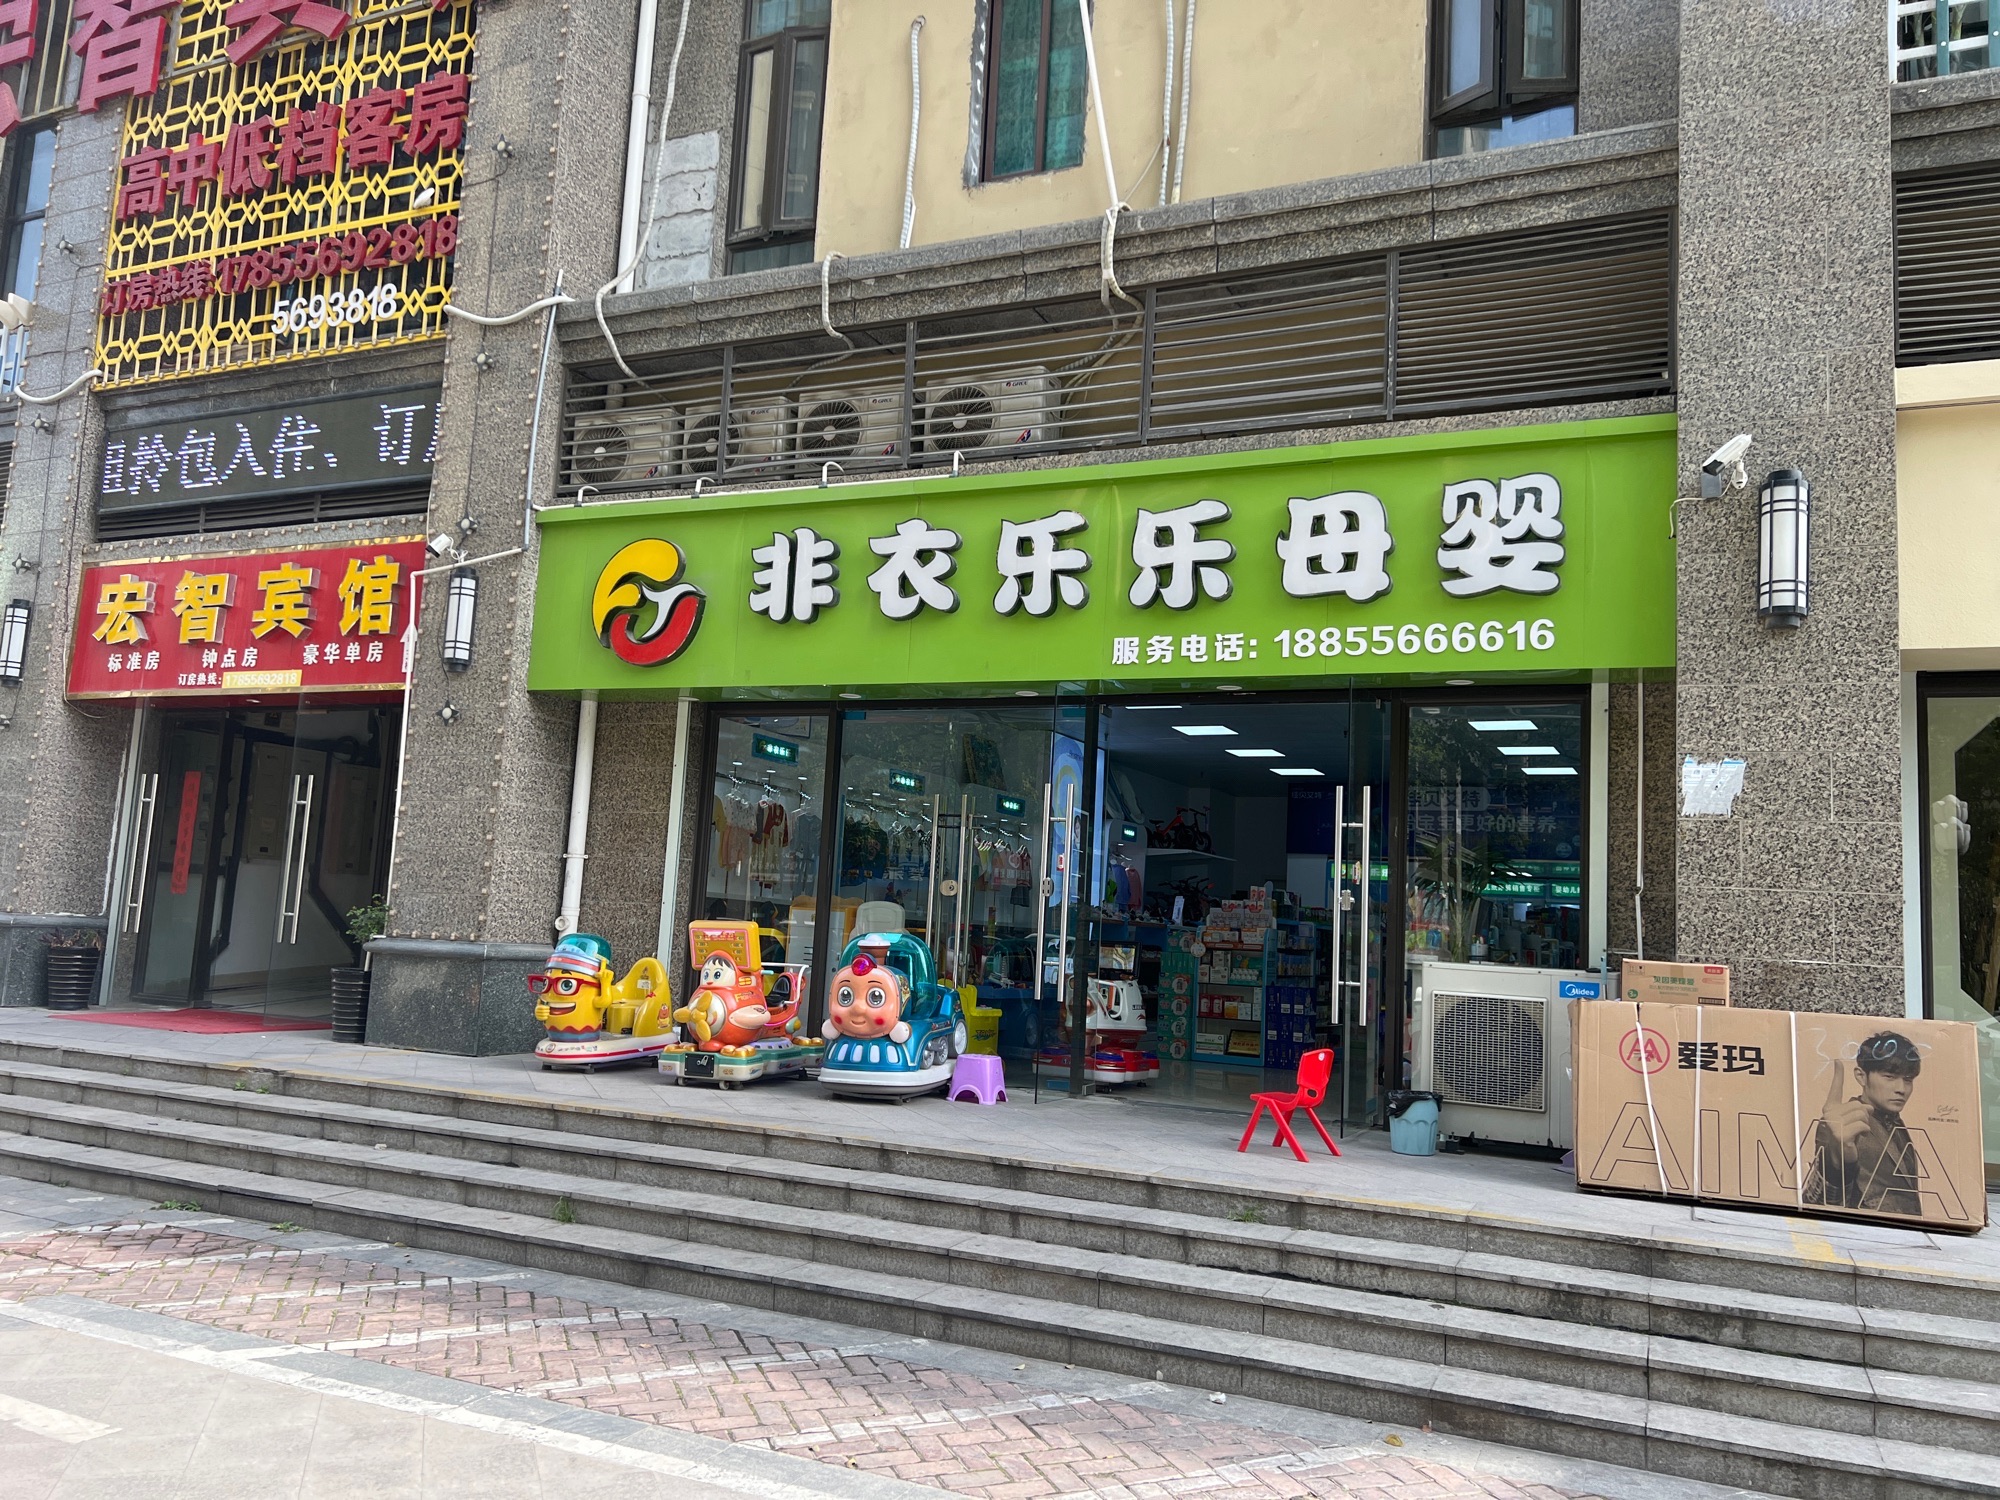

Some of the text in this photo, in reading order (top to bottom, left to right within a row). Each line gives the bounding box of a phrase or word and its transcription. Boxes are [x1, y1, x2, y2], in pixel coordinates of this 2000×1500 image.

[116, 70, 470, 222] 高中低档客房
[271, 282, 398, 336] 5693818
[747, 472, 1566, 625] 非衣乐乐母婴
[92, 554, 402, 647] 宏智宾馆
[107, 651, 161, 673] 标准房
[201, 646, 259, 669] 钟点房
[302, 640, 385, 666] 豪华单房
[1111, 618, 1556, 666] 服务电话: 18855666616
[1677, 1040, 1765, 1075] 爱玛
[1590, 1101, 1969, 1221] AIMA
